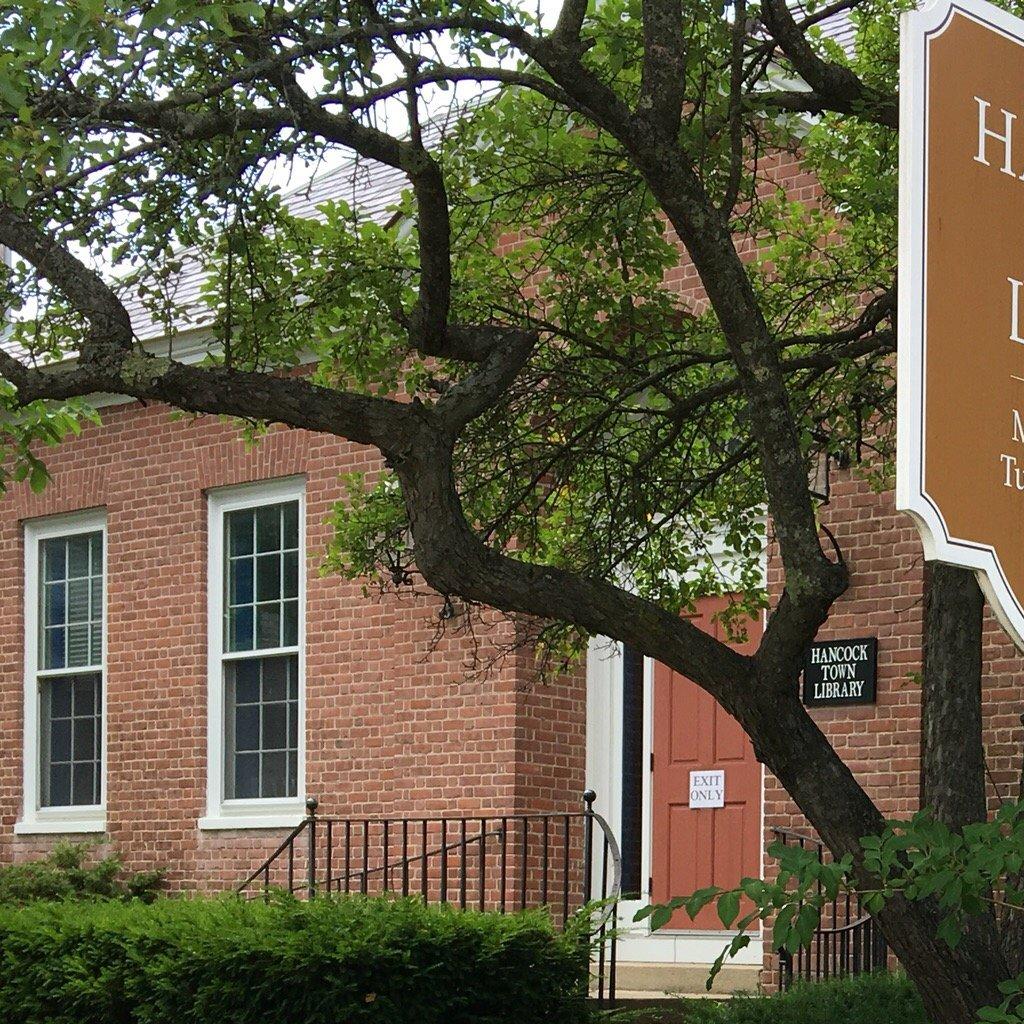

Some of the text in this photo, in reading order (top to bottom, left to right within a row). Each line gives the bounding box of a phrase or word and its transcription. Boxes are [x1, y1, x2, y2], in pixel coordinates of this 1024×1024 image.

[811, 644, 868, 664] HANCOCK
[821, 663, 857, 681] TOWN
[814, 681, 865, 699] LIBRARY
[693, 775, 722, 787] EXIT
[690, 789, 724, 801] ONLY
